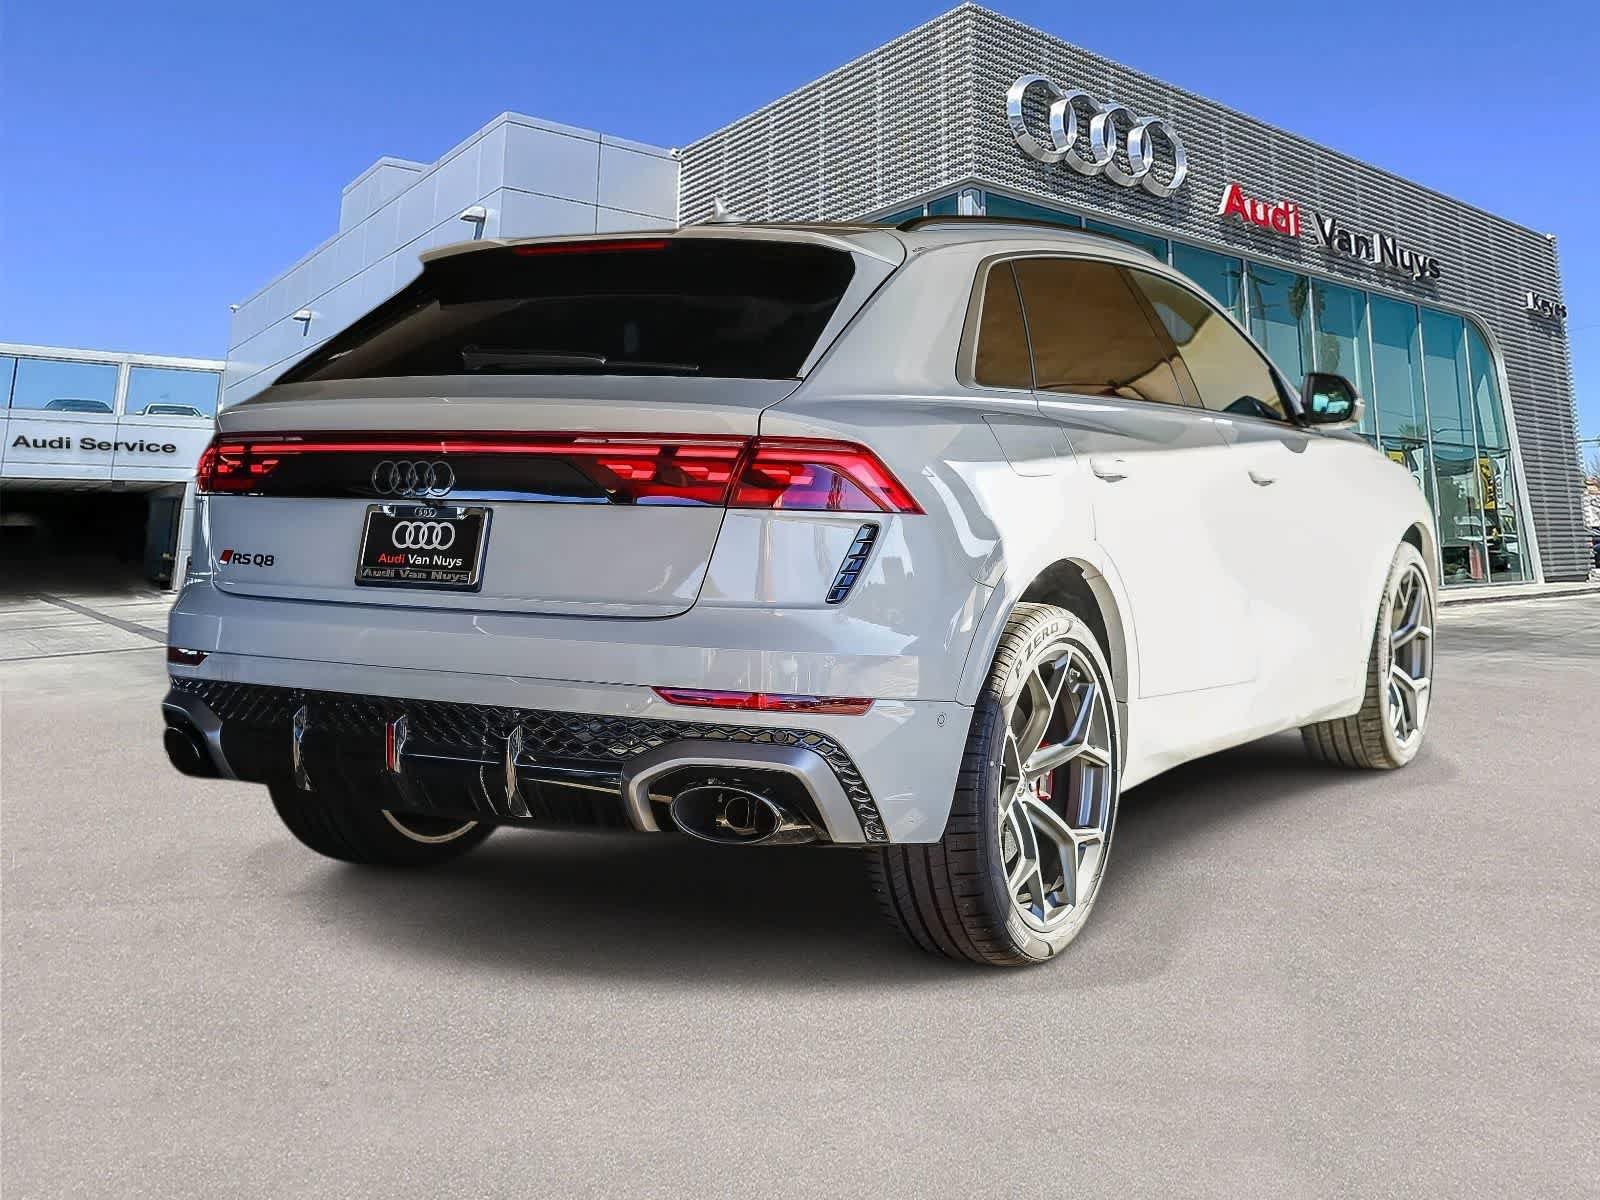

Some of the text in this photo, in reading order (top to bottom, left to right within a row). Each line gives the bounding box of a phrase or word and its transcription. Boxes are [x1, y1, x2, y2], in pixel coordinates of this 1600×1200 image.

[1219, 183, 1441, 280] Audi Van Nuys
[12, 435, 177, 454] Audi Service
[232, 553, 275, 567] RS Q8
[378, 552, 463, 569] Audi Van Nuys
[362, 567, 468, 583] Audi Van Nuys
